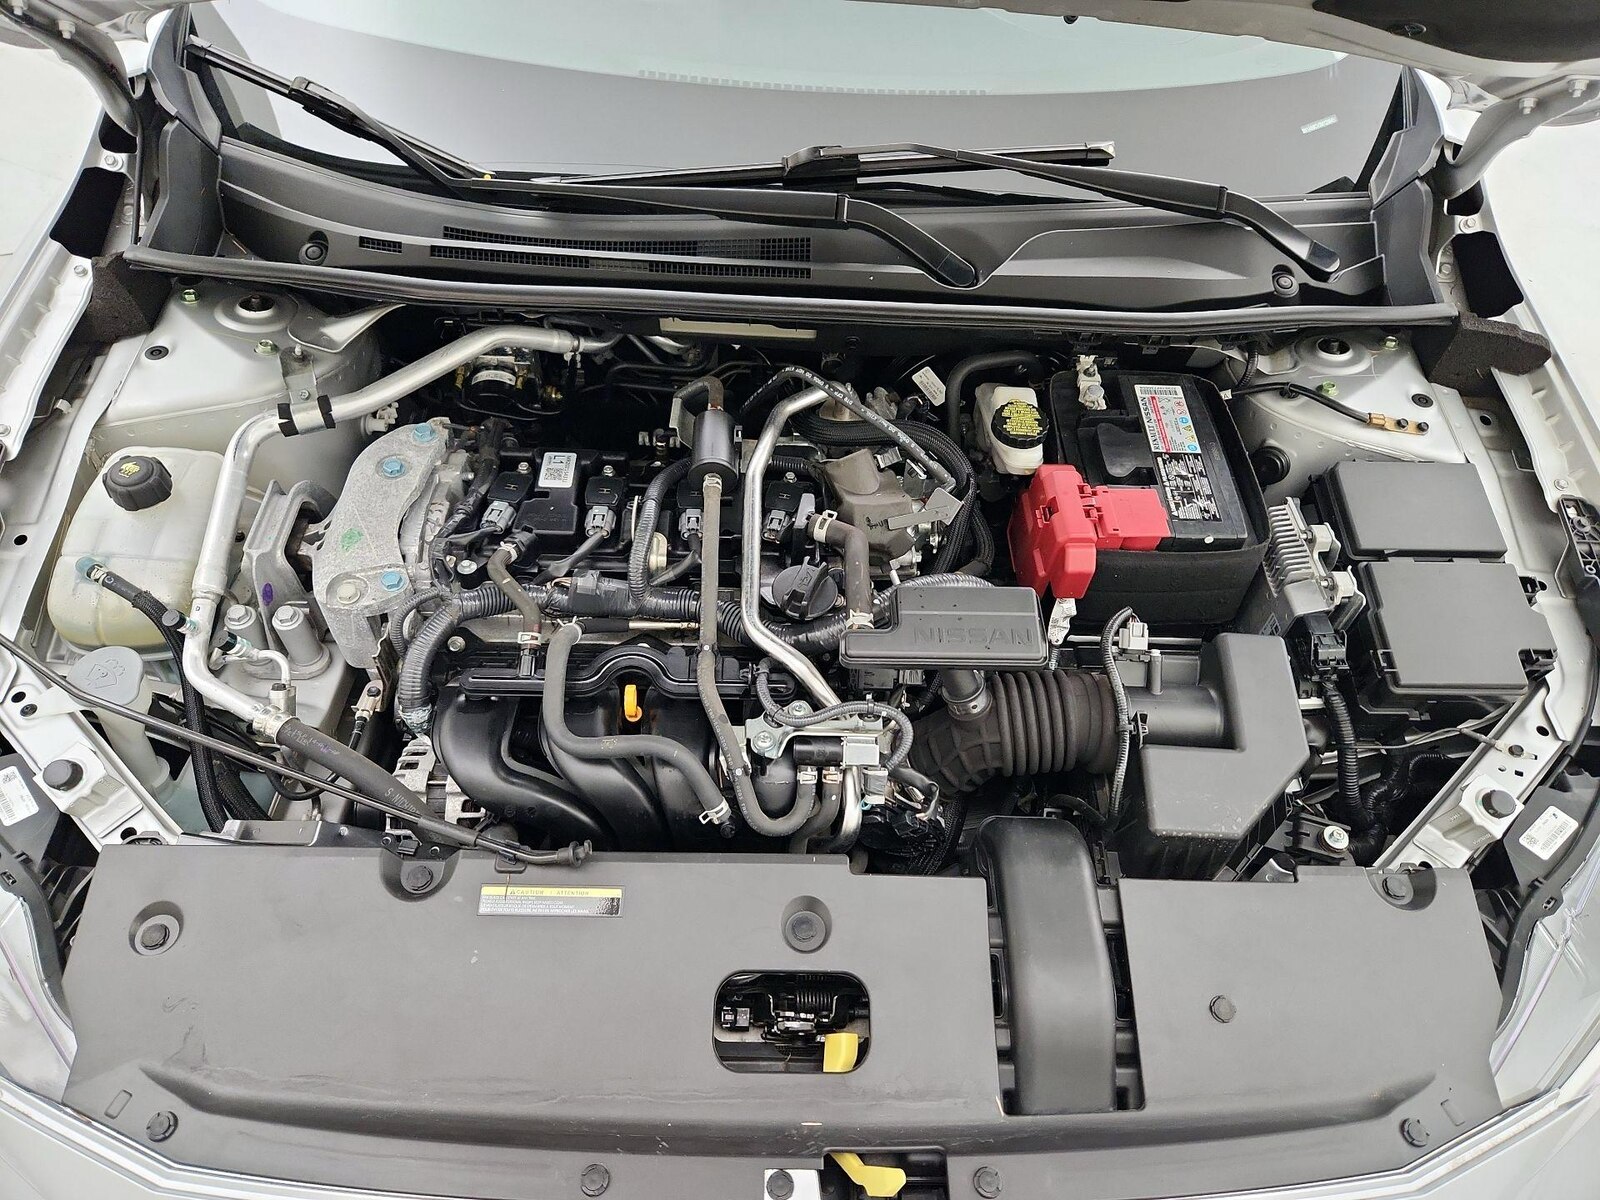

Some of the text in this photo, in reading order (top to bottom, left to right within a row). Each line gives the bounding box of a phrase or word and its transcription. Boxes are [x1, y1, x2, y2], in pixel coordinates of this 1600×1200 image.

[1140, 397, 1152, 423] NISSAN
[1147, 424, 1160, 451] RENAULT
[913, 626, 1034, 646] NISSAN
